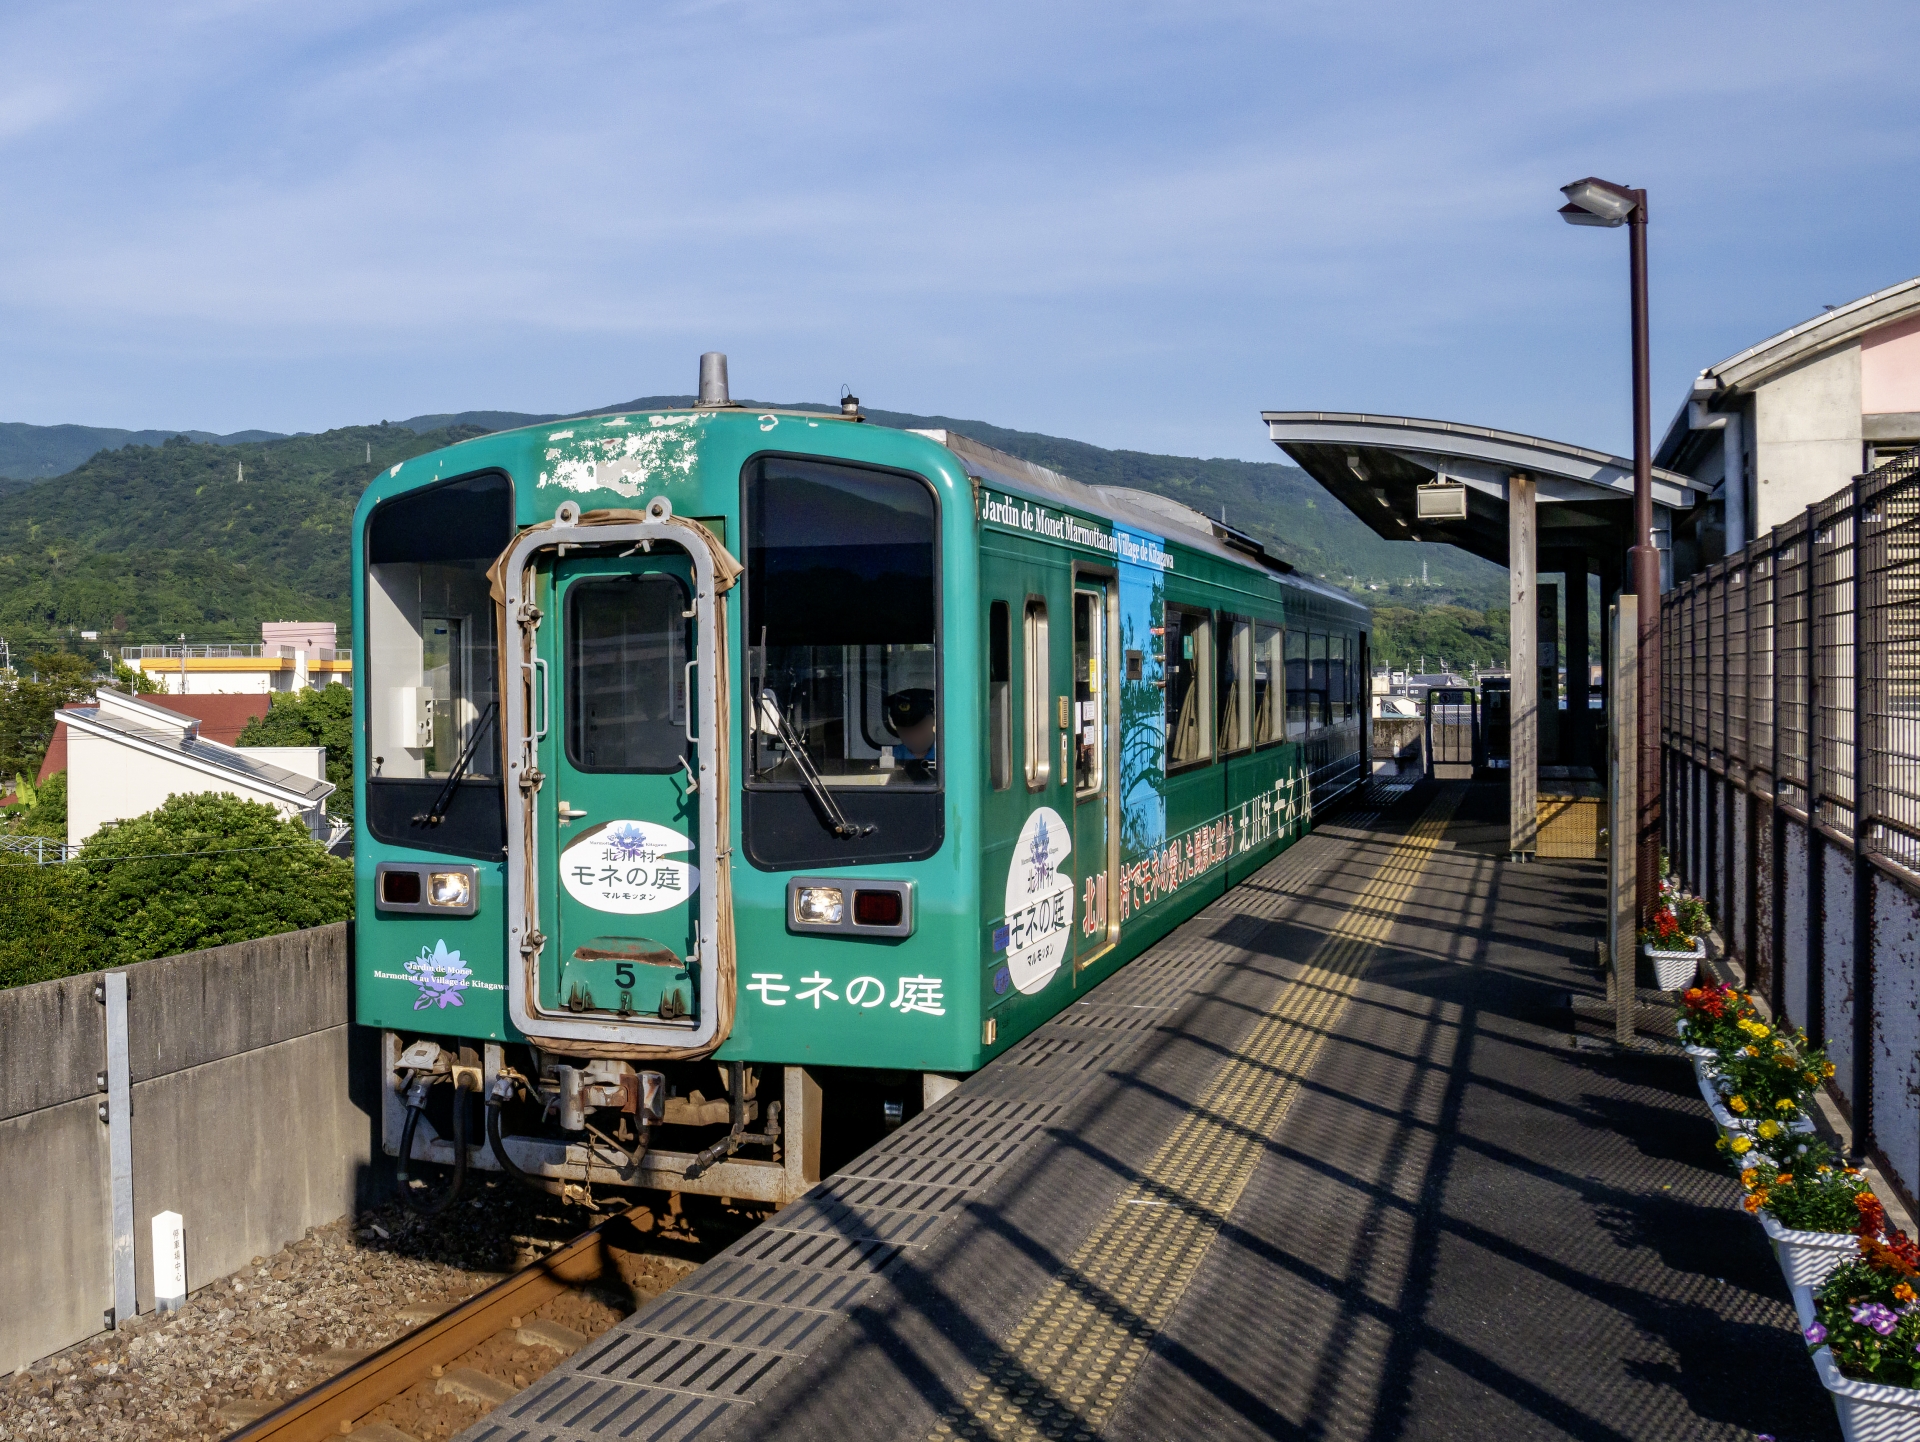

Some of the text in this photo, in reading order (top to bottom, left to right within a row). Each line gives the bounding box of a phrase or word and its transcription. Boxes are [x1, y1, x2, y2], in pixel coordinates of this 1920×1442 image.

[982, 492, 1174, 570] Jardin de Monet Marmottan au Village de Kitagawa
[601, 848, 656, 863] 北川村
[571, 865, 682, 891] モネの庭
[1027, 861, 1055, 895] 北川村
[602, 892, 656, 901] マルモッタン
[1011, 889, 1066, 950] モネの庭
[374, 970, 418, 981] Marmottan
[431, 976, 459, 987] Village
[460, 979, 470, 987] de
[408, 962, 474, 976] Jardin de Monet
[615, 963, 636, 989] 5
[746, 970, 946, 1016] モネの庭
